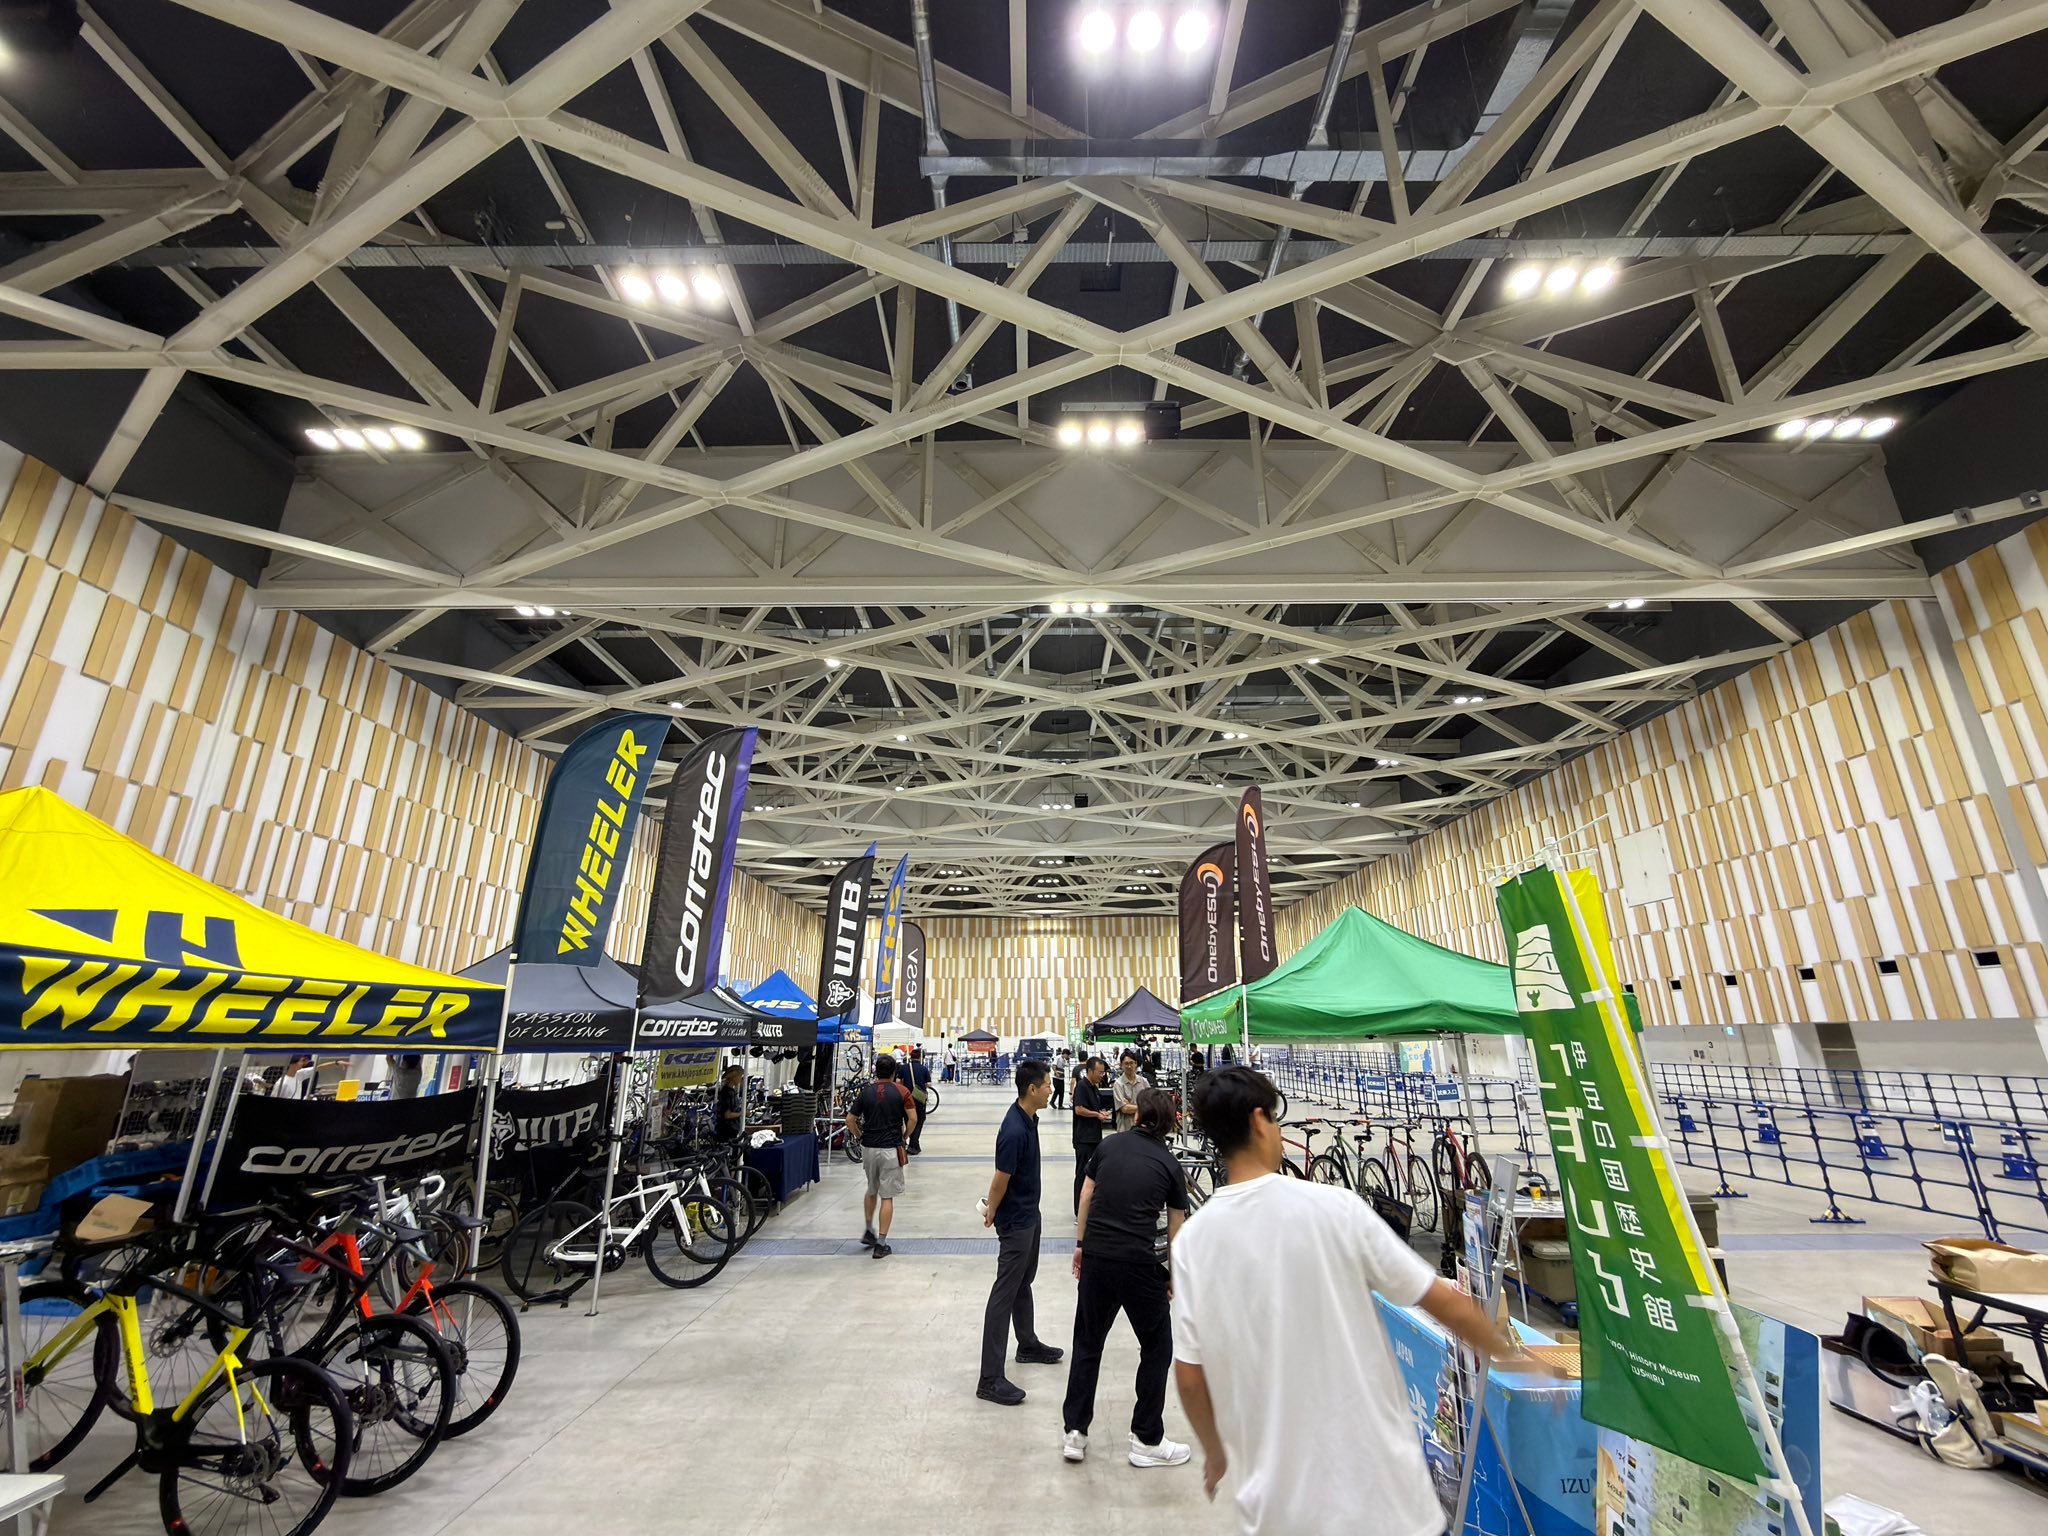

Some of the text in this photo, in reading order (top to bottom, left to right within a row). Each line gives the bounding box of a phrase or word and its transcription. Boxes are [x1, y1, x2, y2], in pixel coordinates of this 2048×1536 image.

[557, 729, 647, 955] WHEELER
[675, 751, 726, 987] corratec
[833, 880, 862, 977] WTB
[1207, 883, 1219, 983] OnebyESU
[19, 955, 471, 1038] WHEELER
[508, 1026, 610, 1038] OF CYCLING
[512, 1012, 597, 1024] PASSION
[639, 1017, 719, 1037] corratec
[664, 1051, 717, 1065] KHS
[1707, 1041, 1714, 1049] 3
[240, 1124, 466, 1174] corratec
[1659, 1363, 1701, 1383] Museum
